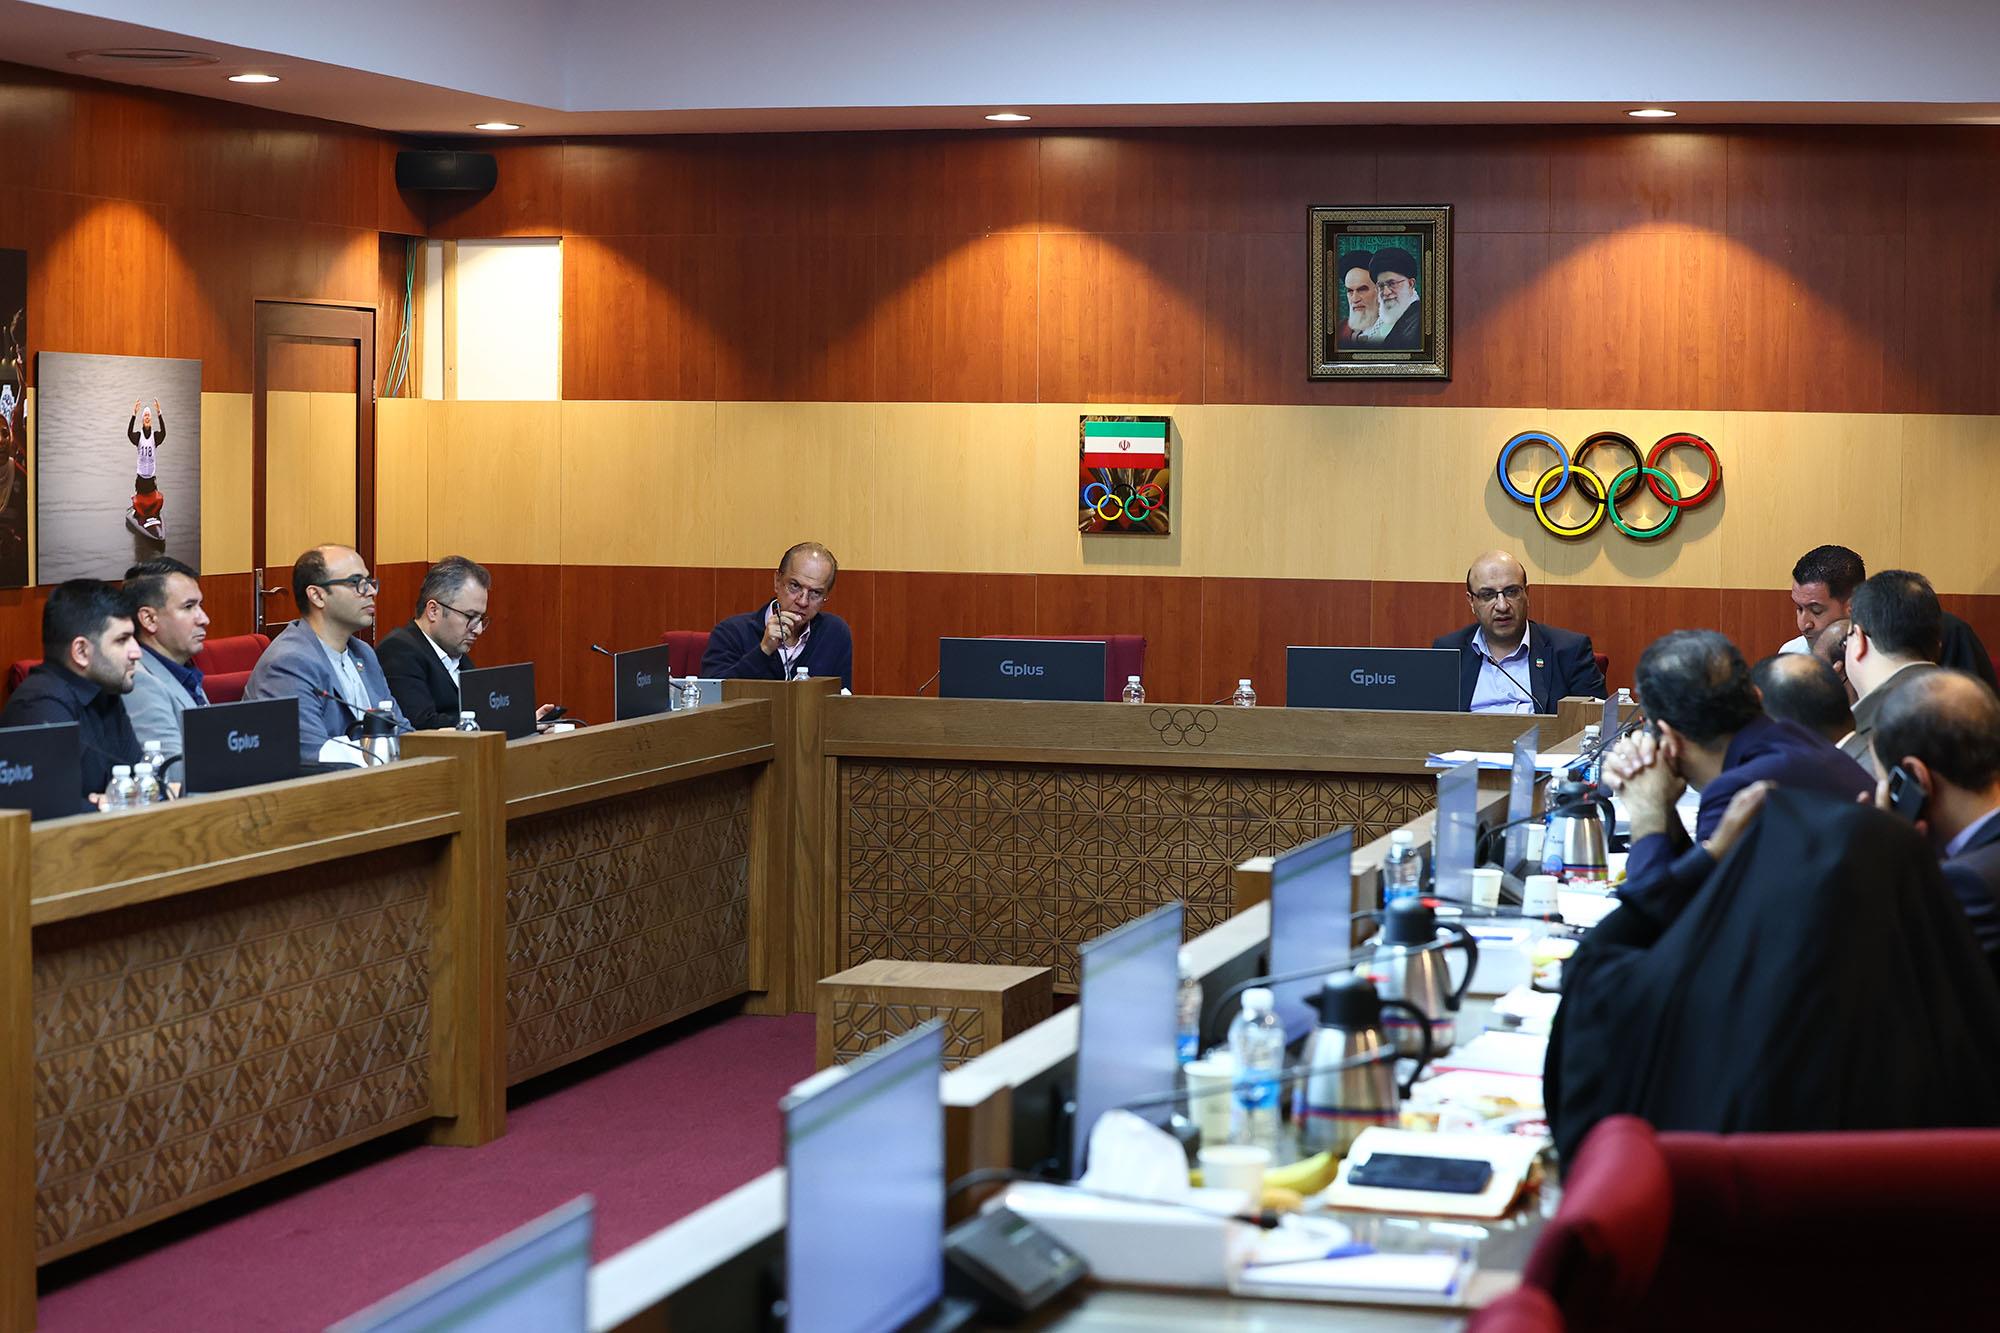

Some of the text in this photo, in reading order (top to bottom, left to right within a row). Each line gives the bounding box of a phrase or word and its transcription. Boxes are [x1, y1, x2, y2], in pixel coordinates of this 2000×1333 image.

[141, 446, 153, 457] 118
[1000, 660, 1044, 677] Gplus
[1350, 669, 1395, 686] Gplus
[489, 691, 510, 710] Gplus
[227, 730, 260, 752] Gplus
